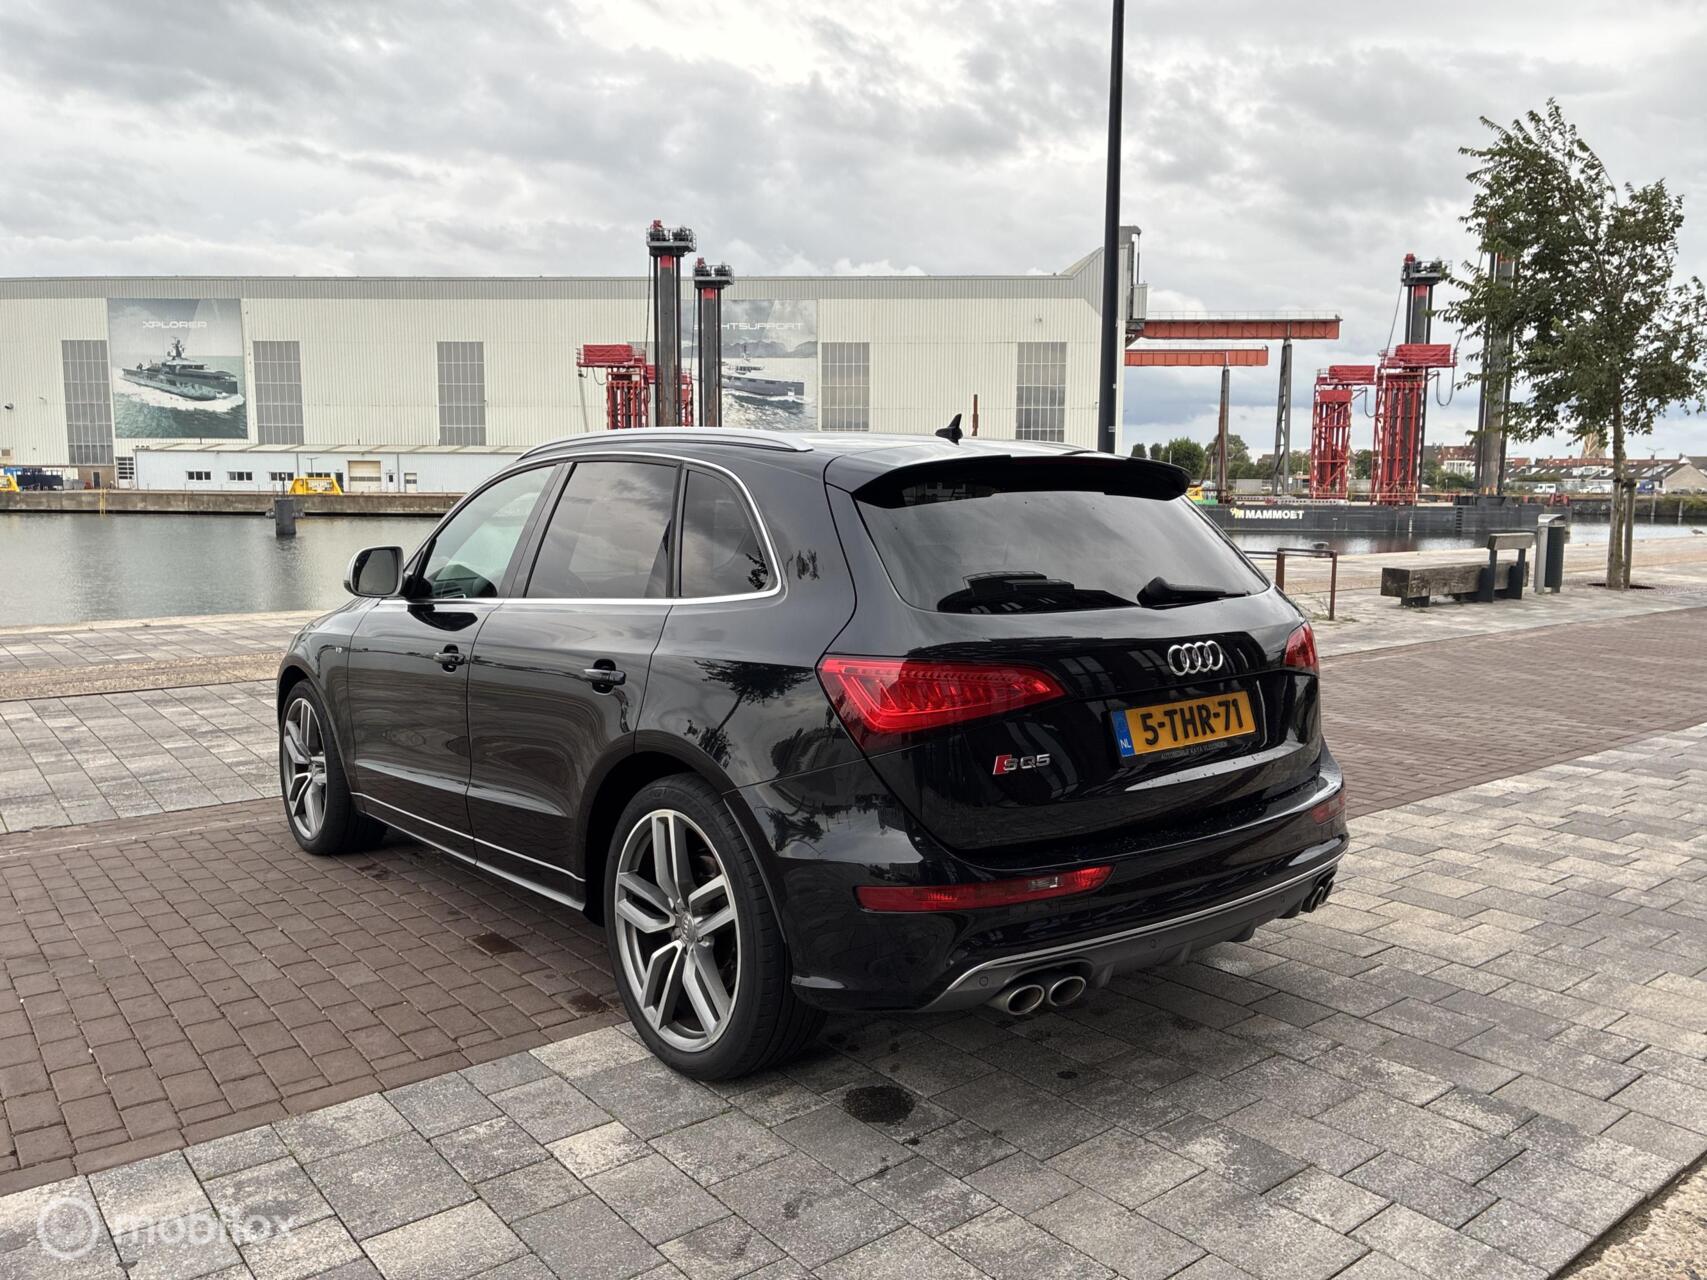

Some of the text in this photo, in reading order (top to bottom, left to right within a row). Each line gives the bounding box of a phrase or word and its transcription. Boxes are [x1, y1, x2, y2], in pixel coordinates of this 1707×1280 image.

[142, 320, 208, 329] XPLORER
[693, 322, 802, 330] HTSUPPORT
[1245, 509, 1304, 519] MAMMOET
[1140, 698, 1243, 746] 5-THR-71
[1120, 739, 1132, 749] NL
[1003, 753, 1050, 771] SQ5
